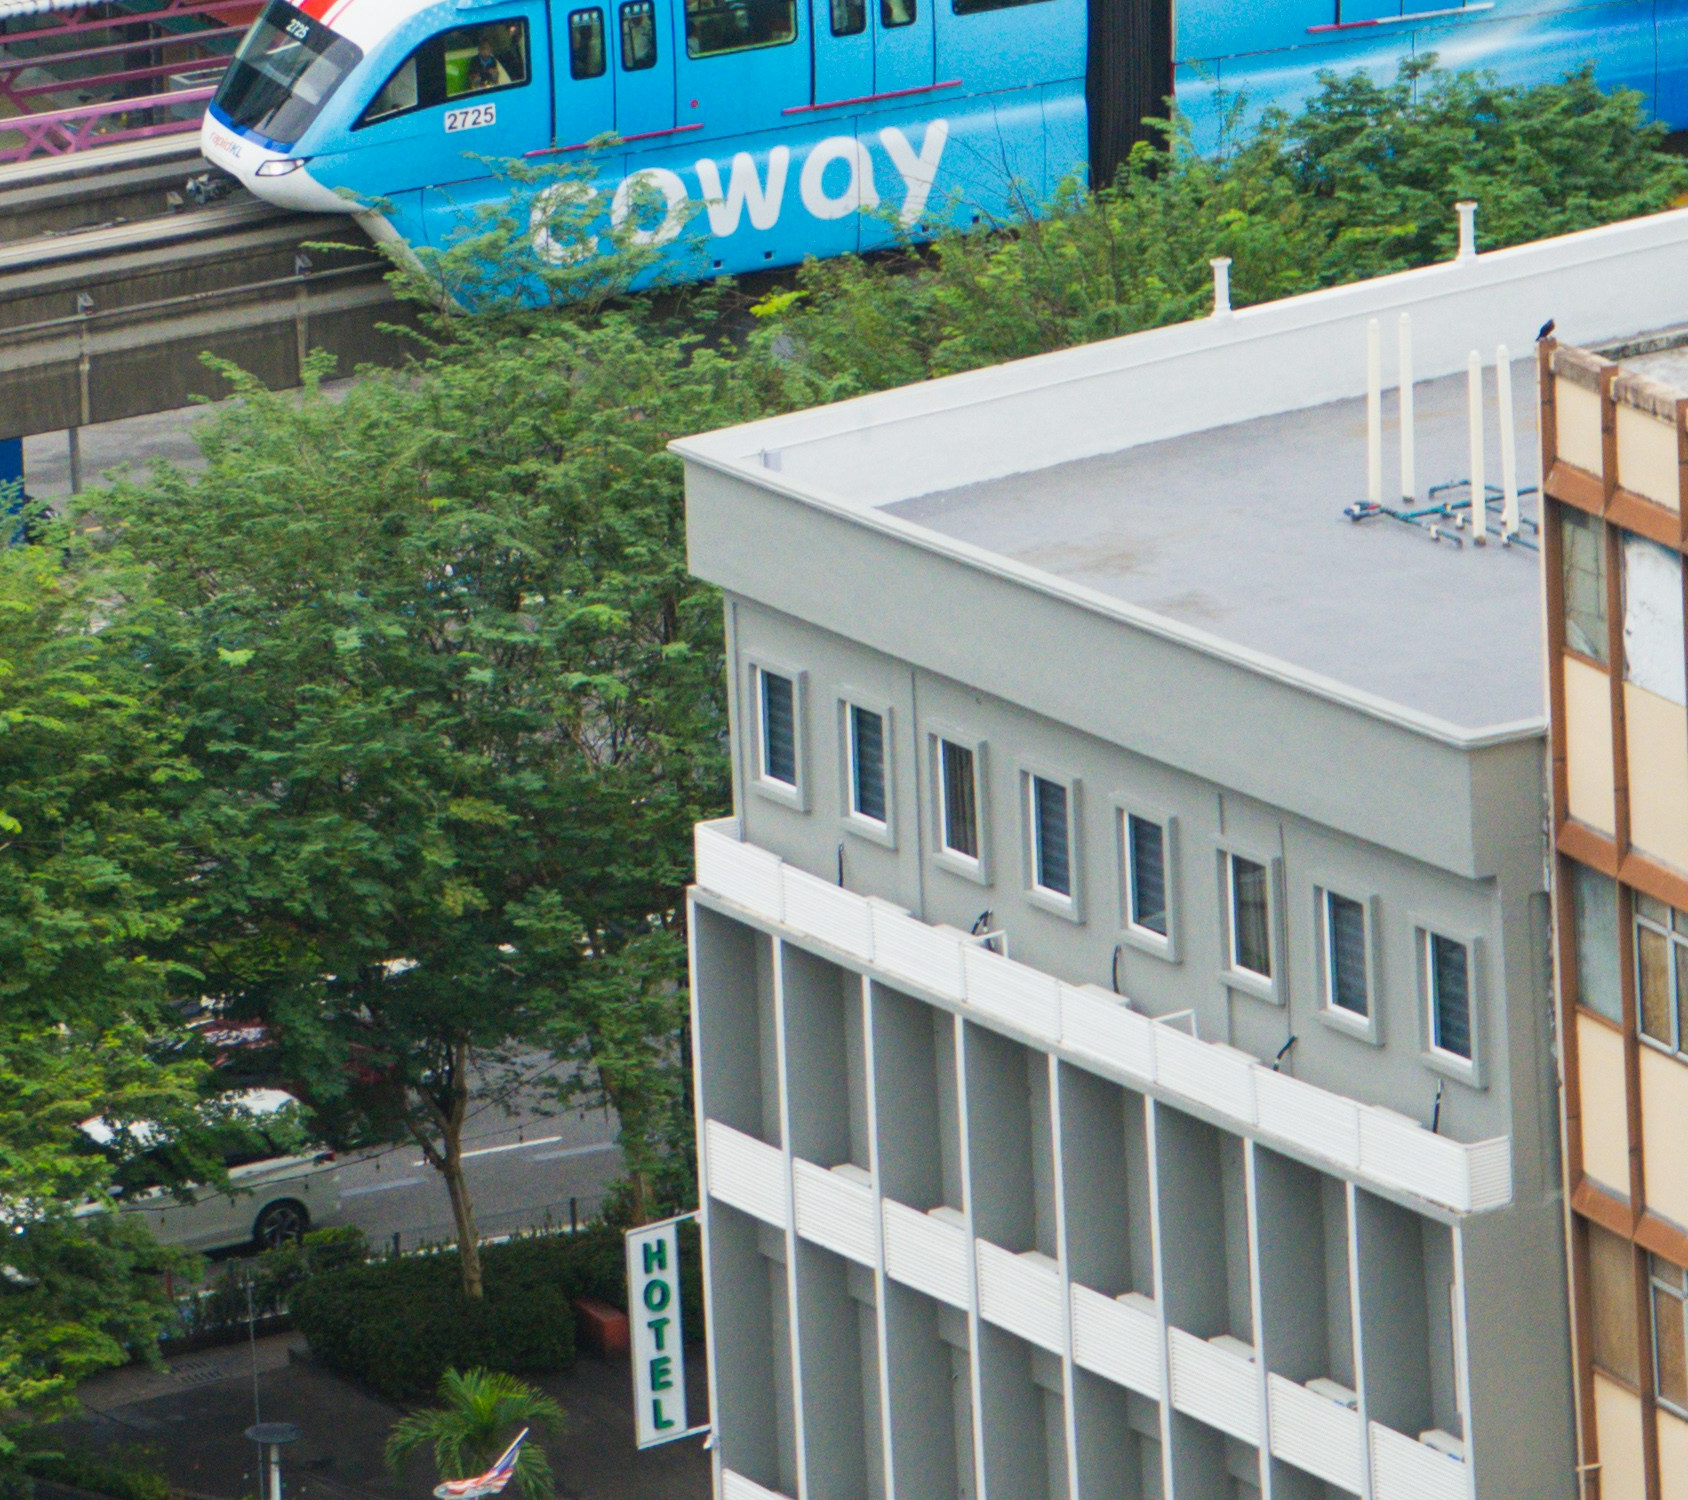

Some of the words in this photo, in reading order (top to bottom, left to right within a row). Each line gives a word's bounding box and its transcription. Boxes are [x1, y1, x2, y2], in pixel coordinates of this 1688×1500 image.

[285, 17, 310, 40] 2725
[446, 105, 495, 132] 2725
[528, 117, 950, 267] coway
[642, 1238, 675, 1431] HOTEL
